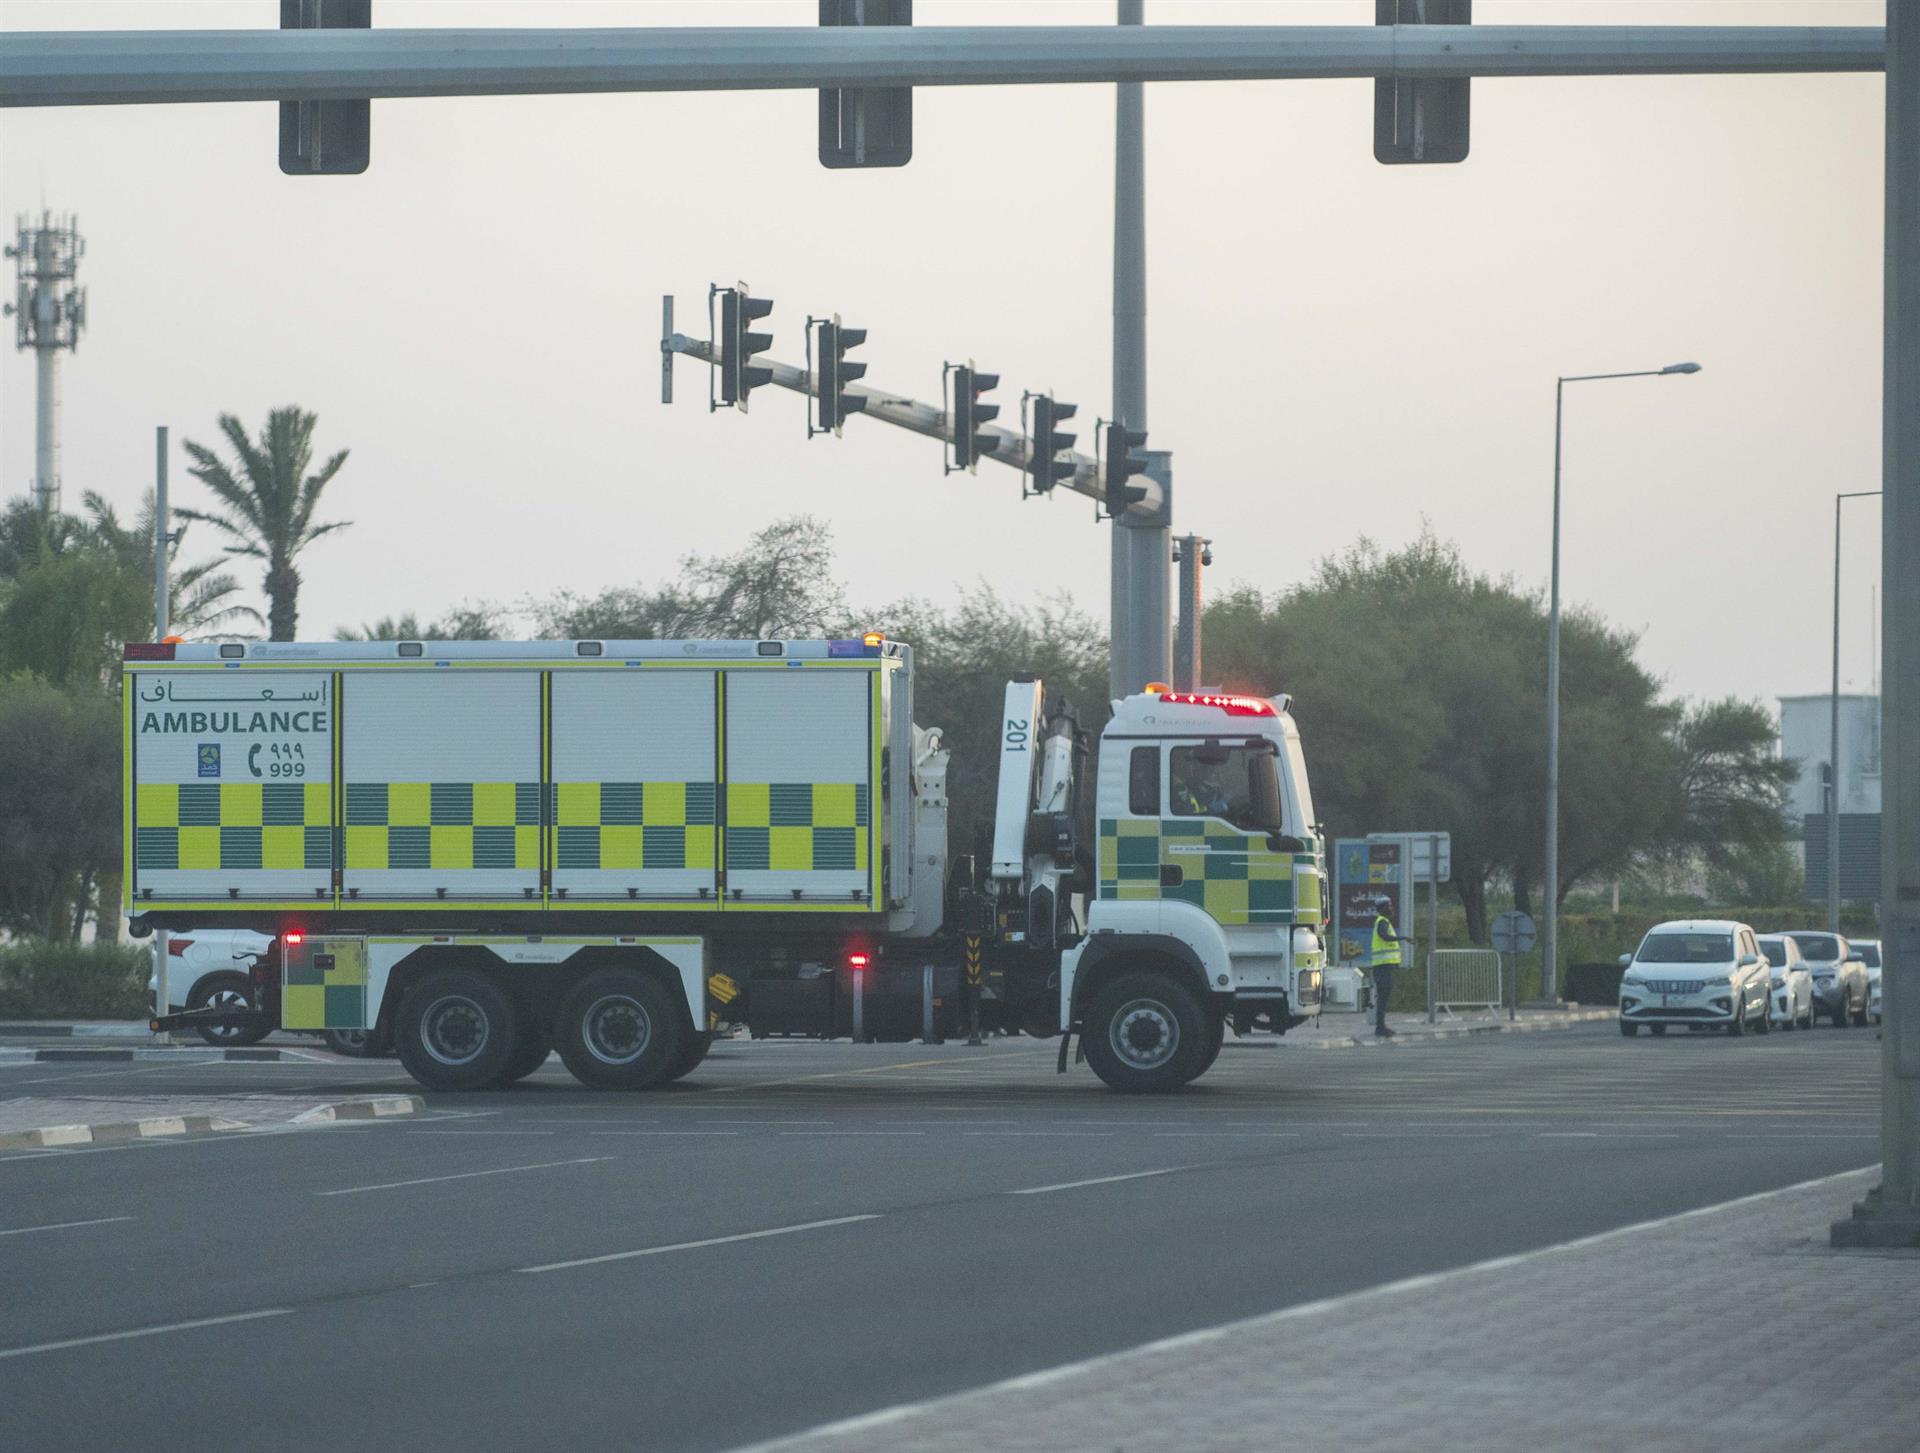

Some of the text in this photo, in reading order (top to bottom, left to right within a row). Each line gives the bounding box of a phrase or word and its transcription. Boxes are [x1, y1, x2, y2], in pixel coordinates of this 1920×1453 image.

[141, 679, 327, 706] إسعاف
[141, 711, 327, 733] AMBULANCE
[1006, 719, 1028, 752] 201
[270, 742, 304, 760] ٩٩٩
[270, 762, 305, 777] 999
